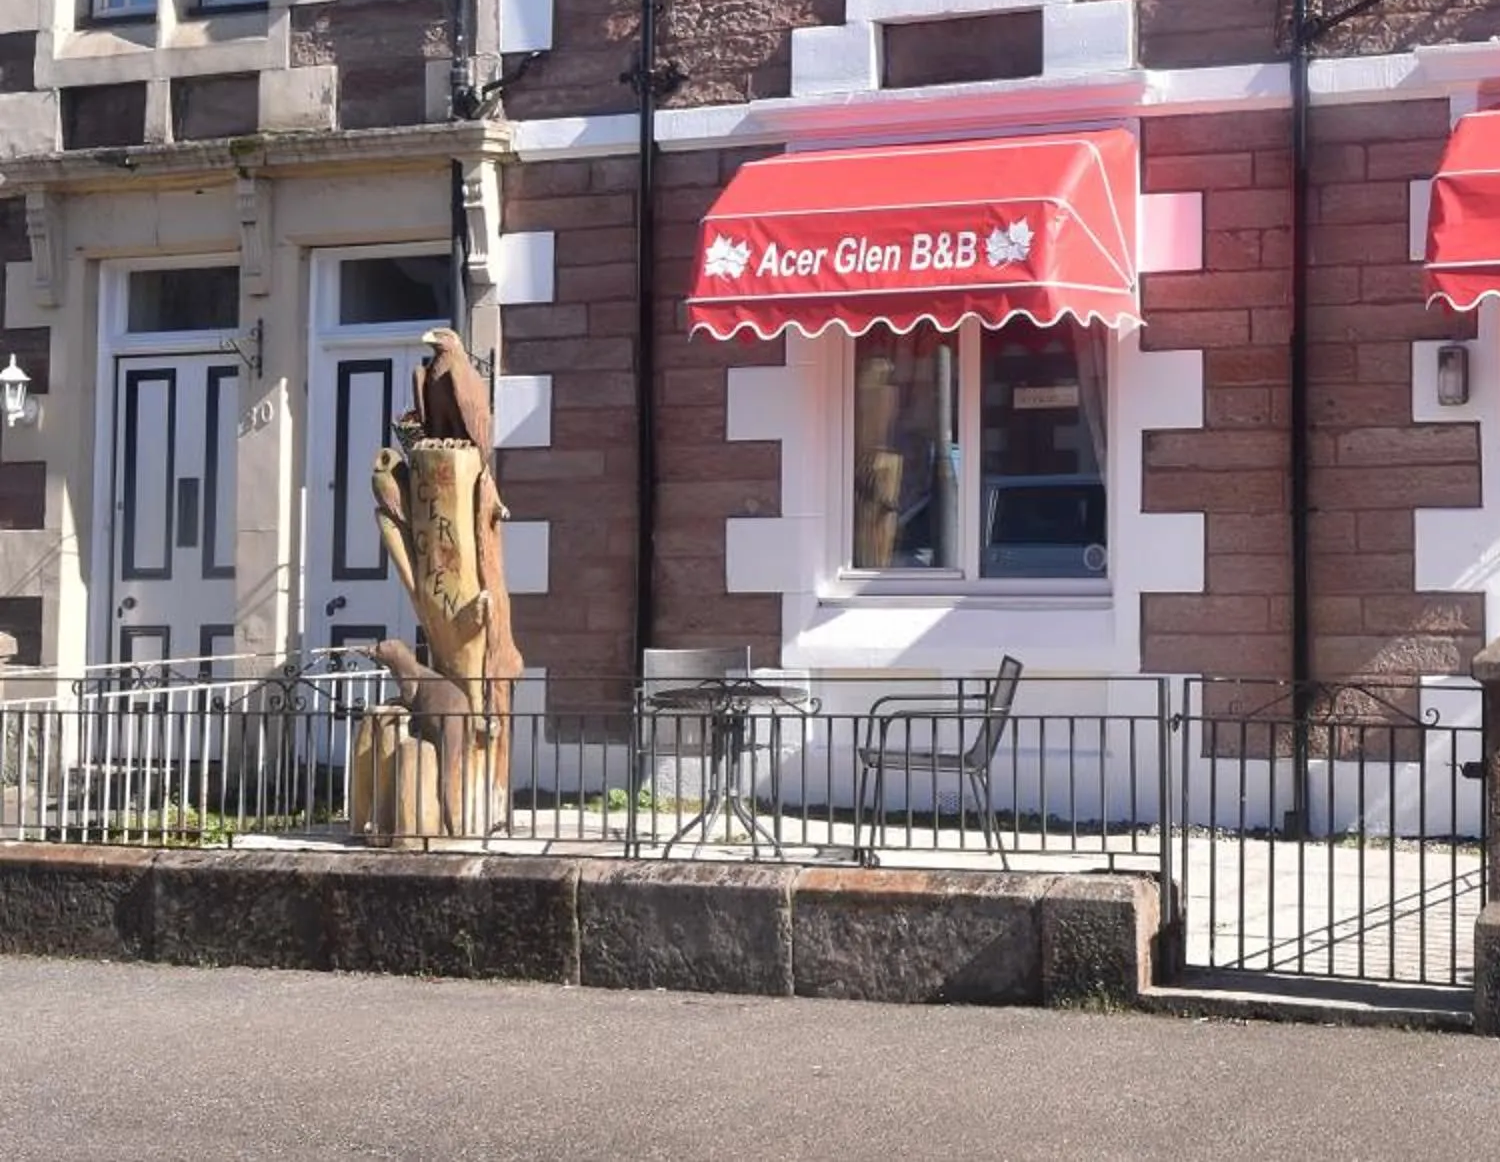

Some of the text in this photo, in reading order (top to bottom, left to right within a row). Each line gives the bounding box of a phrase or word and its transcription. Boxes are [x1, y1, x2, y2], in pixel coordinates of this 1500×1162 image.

[756, 231, 977, 277] Acer Glen B&B
[411, 455, 455, 545] ACER
[416, 530, 460, 619] GLEN
